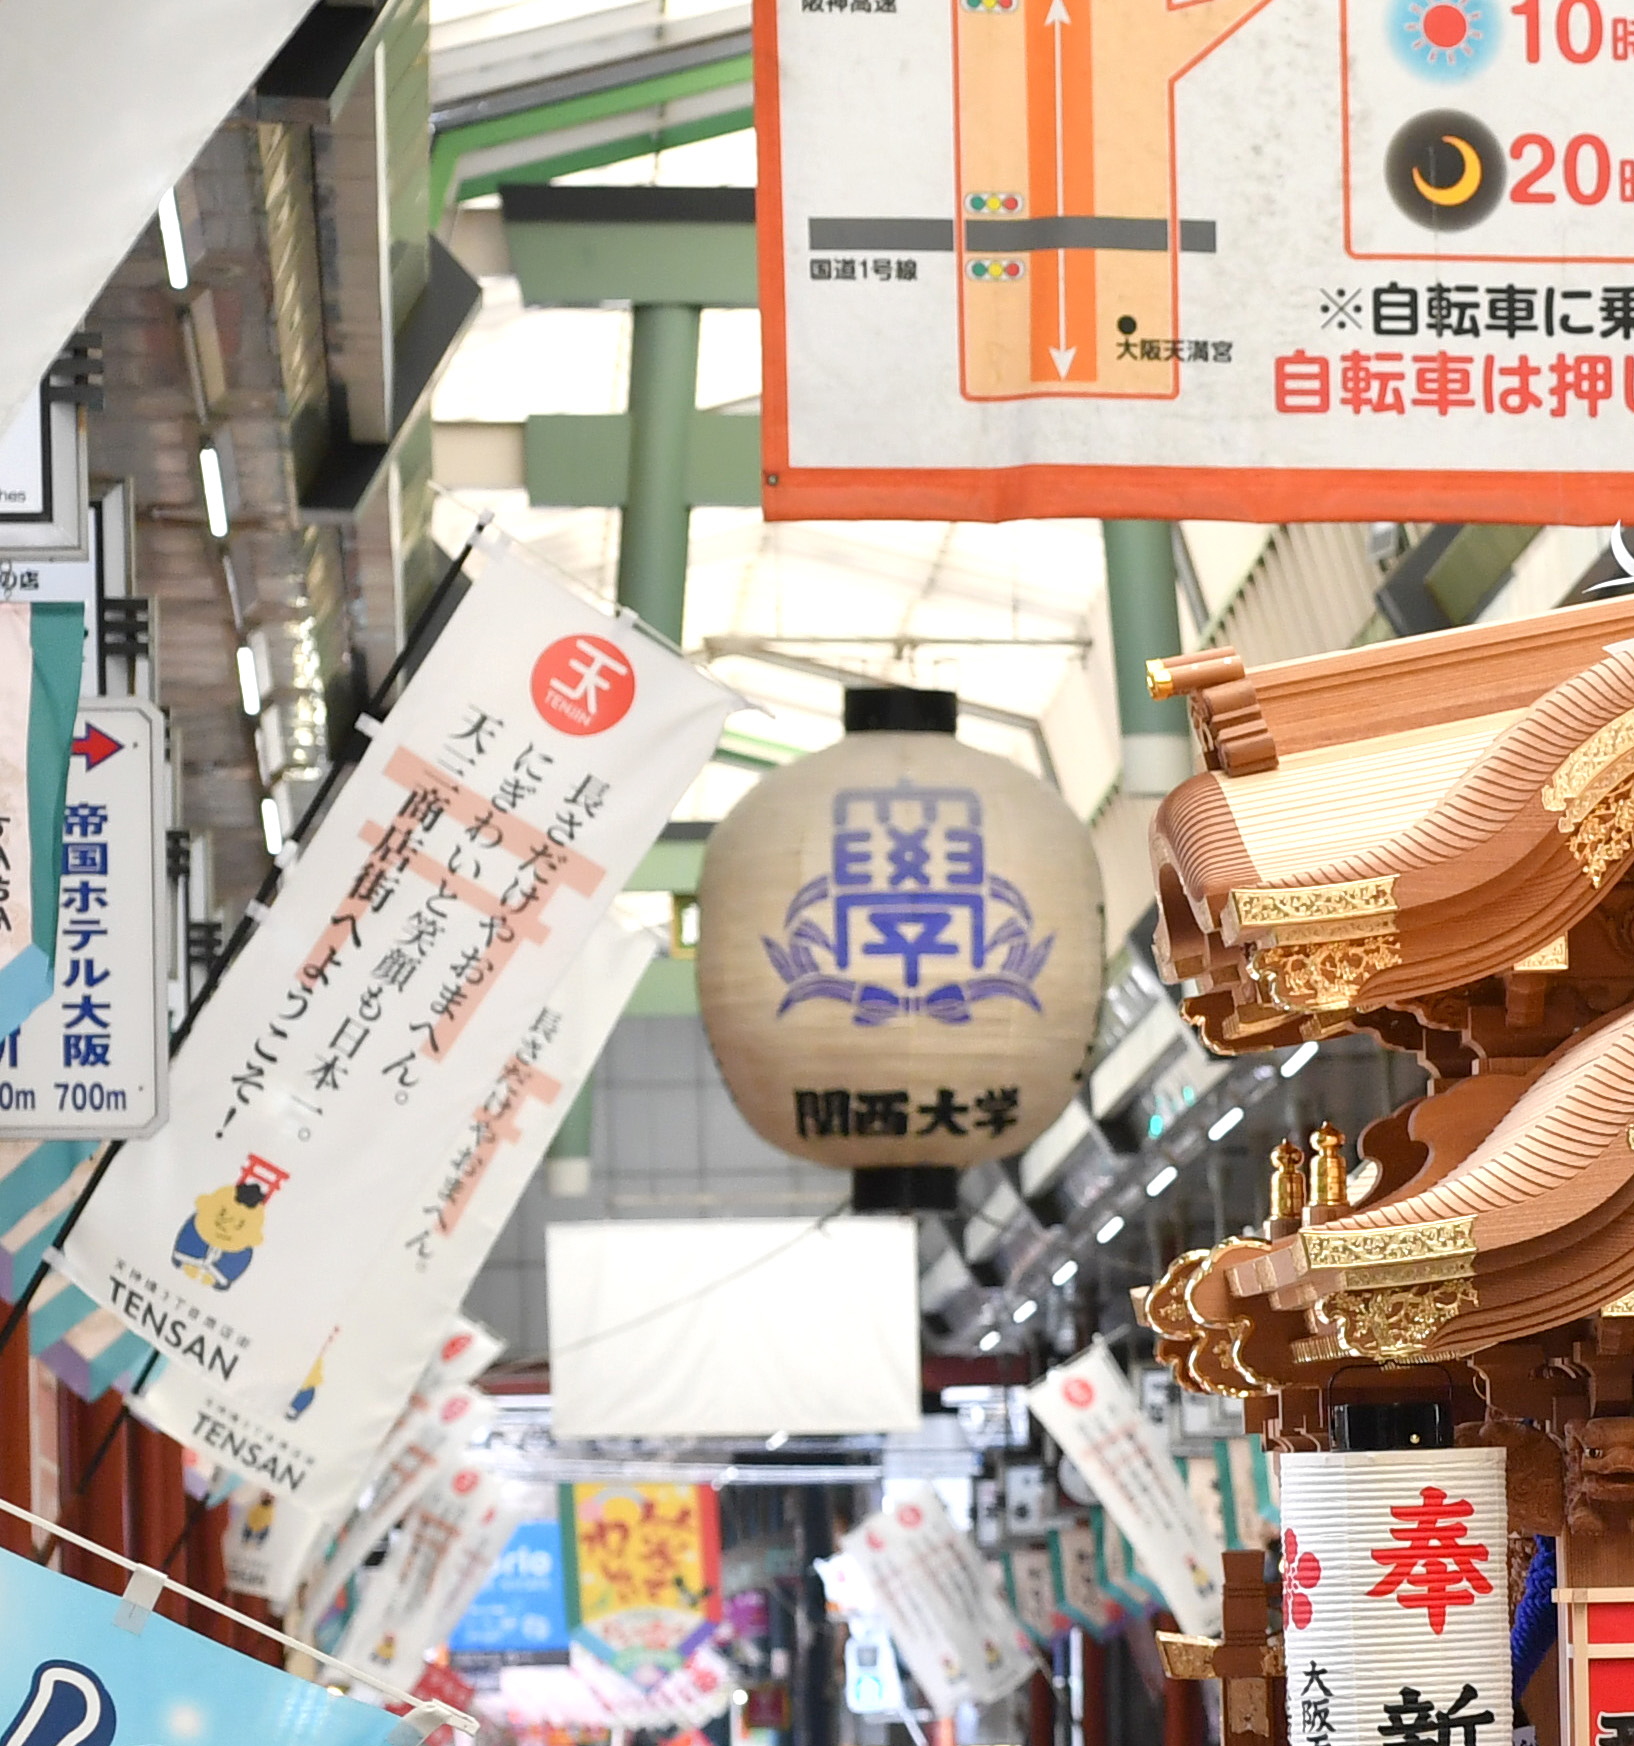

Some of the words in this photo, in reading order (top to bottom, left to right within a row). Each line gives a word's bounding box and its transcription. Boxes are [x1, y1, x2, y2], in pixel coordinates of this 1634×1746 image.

[809, 257, 919, 283] 国道1号線
[1116, 338, 1234, 364] 大阪天満宮
[549, 638, 629, 716] 天
[60, 803, 112, 1069] 帝国ホテル大阪
[53, 1082, 127, 1112] 700m
[794, 1086, 1020, 1141] 関西大学
[108, 1275, 240, 1383] TENSAN
[191, 1409, 306, 1492] TENSAN
[1365, 1486, 1494, 1636] 奉
